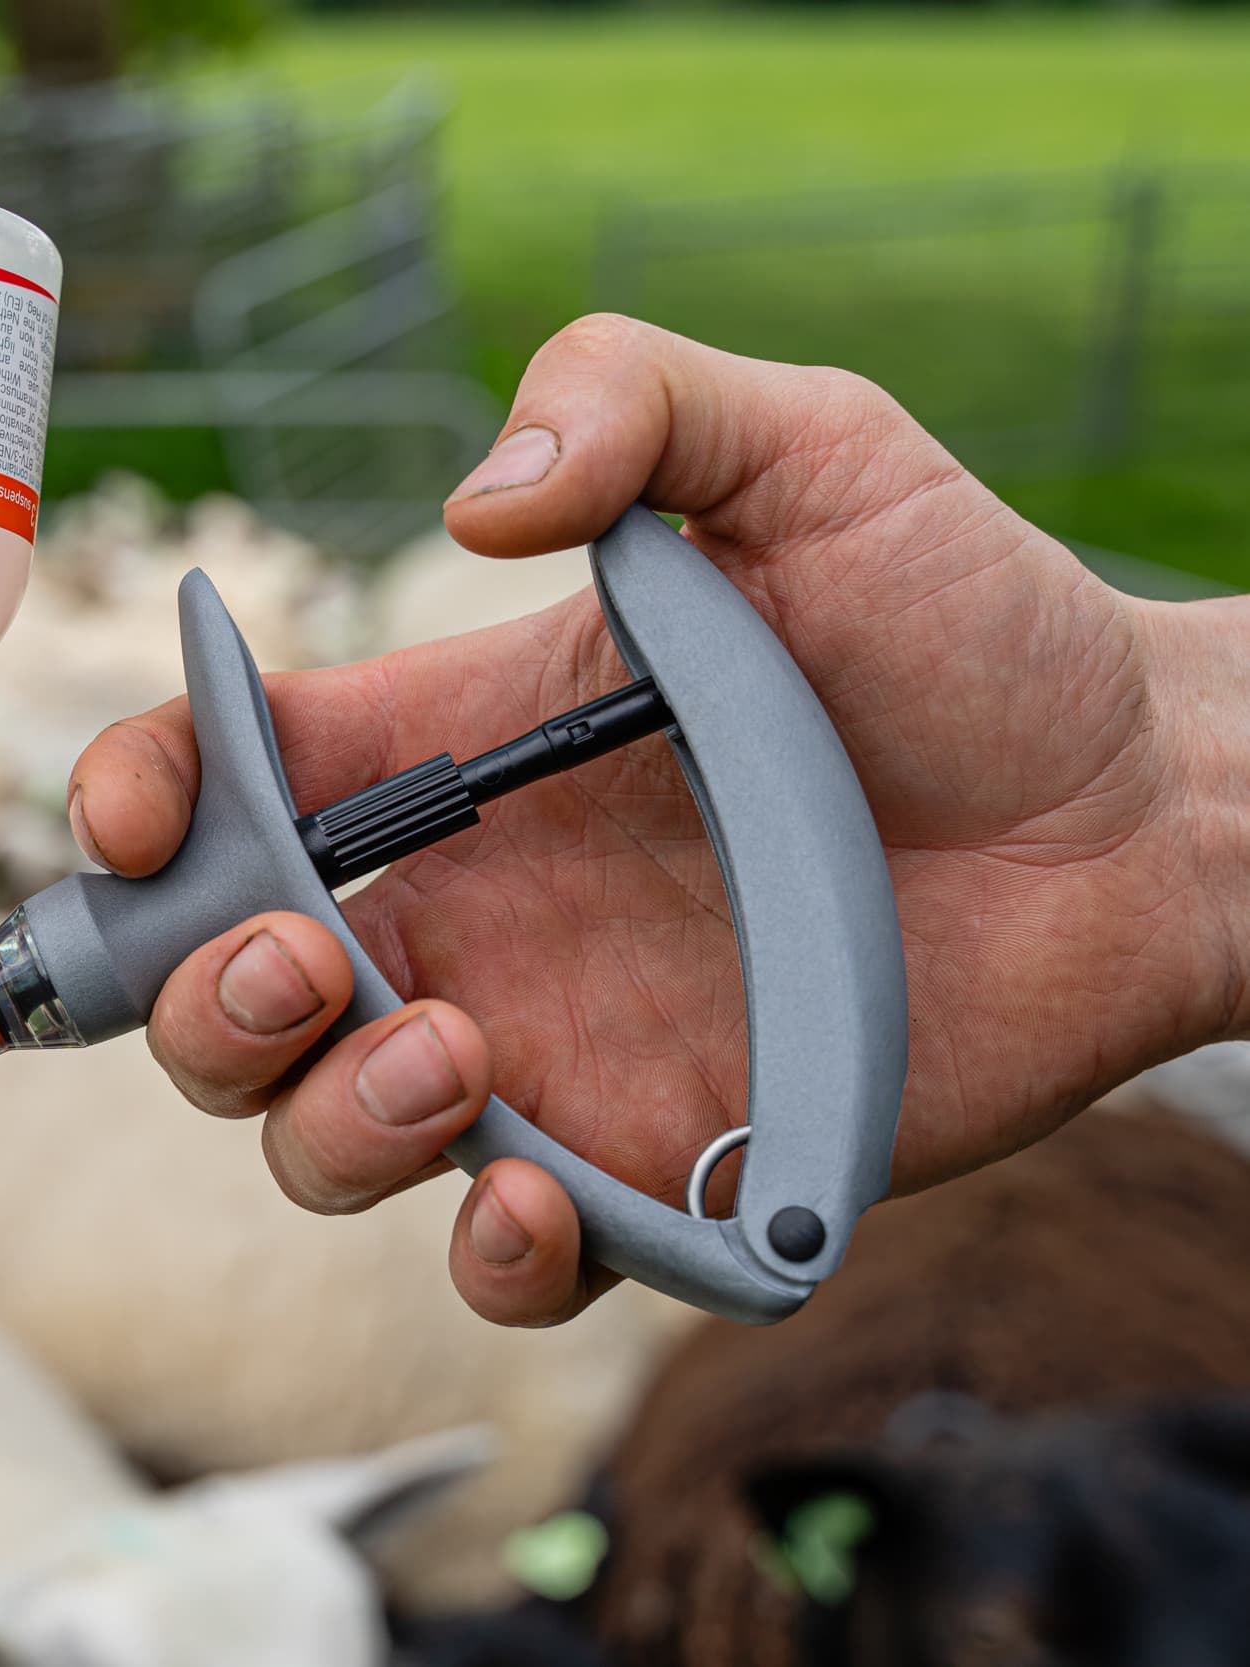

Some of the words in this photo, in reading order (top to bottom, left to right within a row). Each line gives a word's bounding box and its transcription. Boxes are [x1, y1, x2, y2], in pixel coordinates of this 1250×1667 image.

[3, 291, 24, 313] (EU)
[23, 317, 35, 333] the
[19, 330, 35, 348] Non
[22, 347, 39, 366] from
[19, 360, 38, 381] Store
[0, 429, 30, 454] Infective
